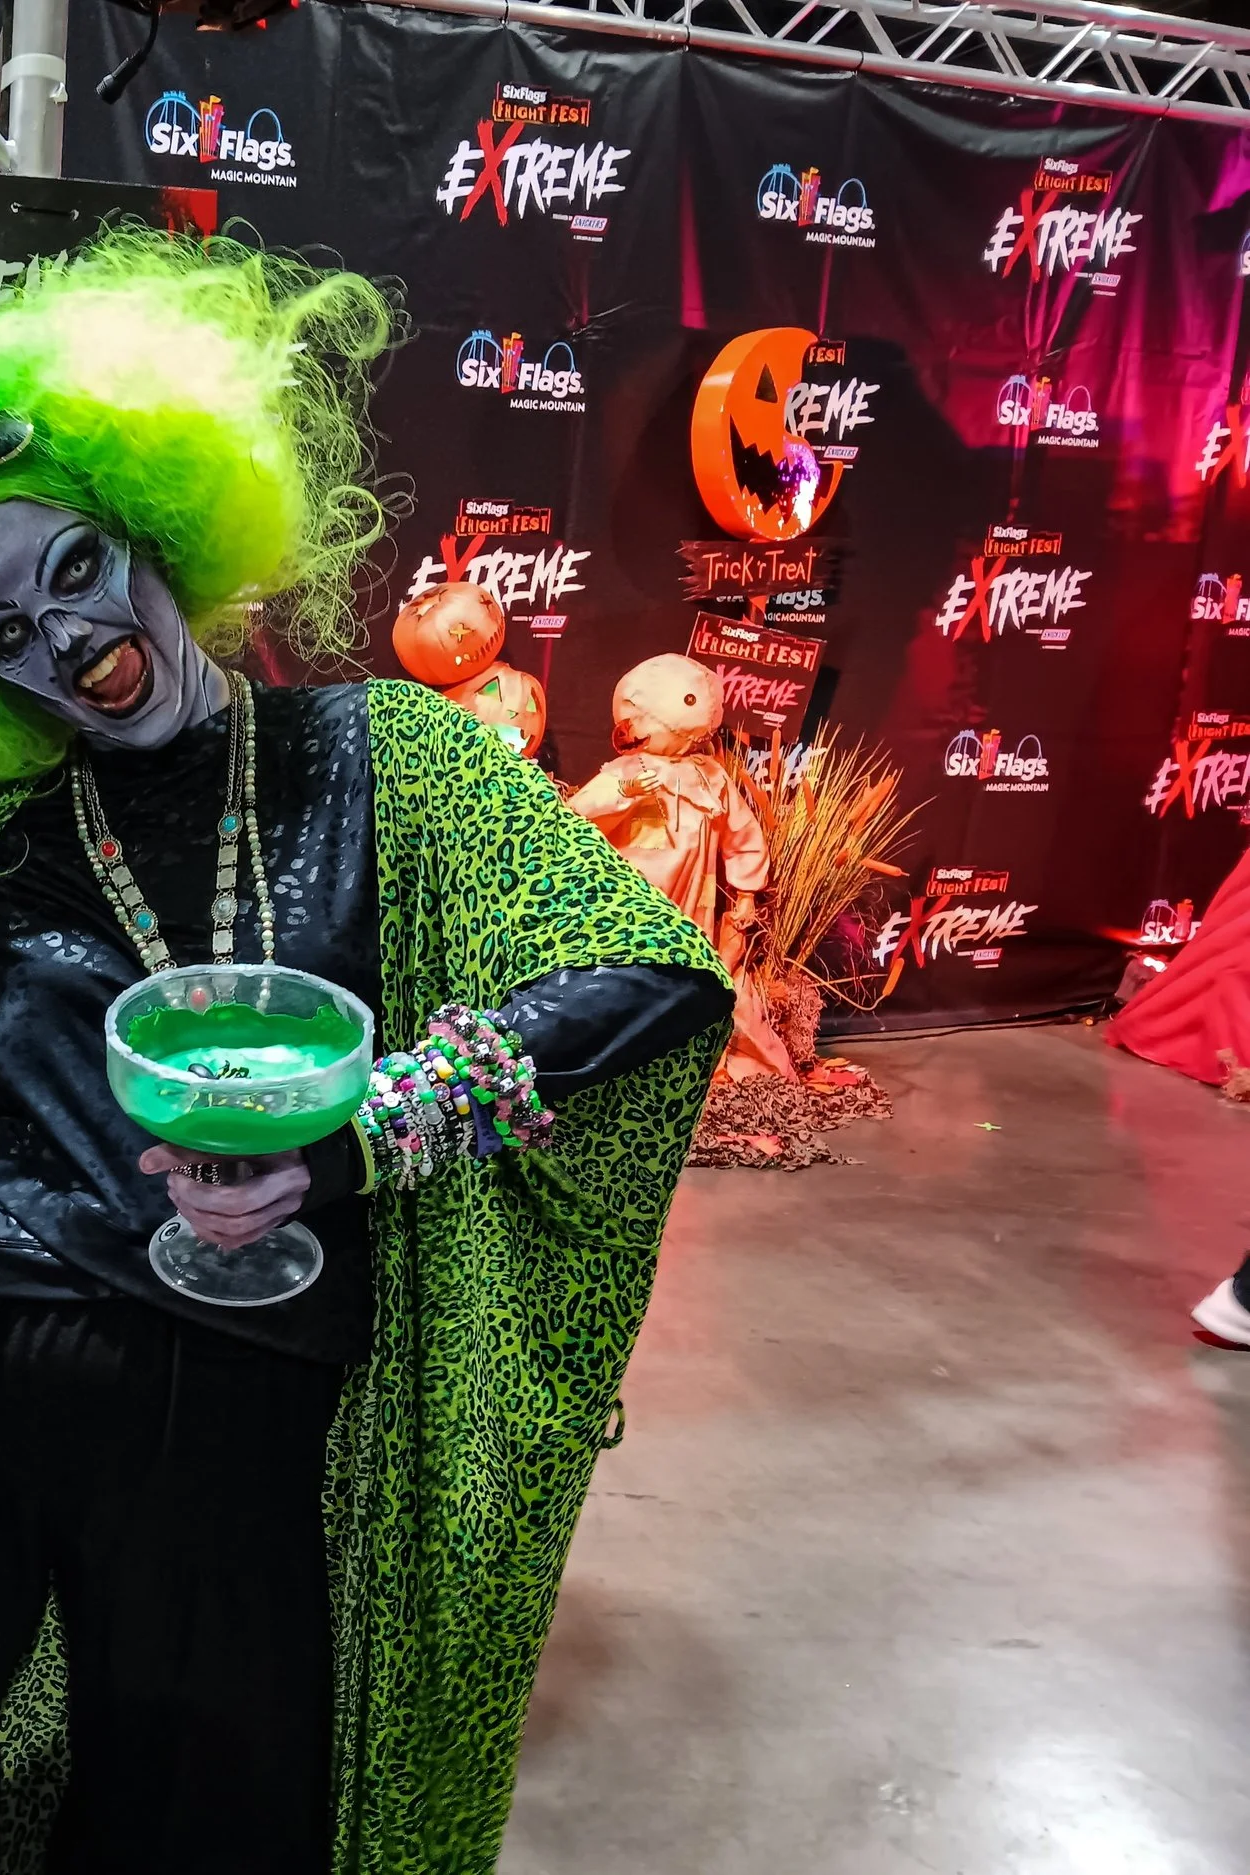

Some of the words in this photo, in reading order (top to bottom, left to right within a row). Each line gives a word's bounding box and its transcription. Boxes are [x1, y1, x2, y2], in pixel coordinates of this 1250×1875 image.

[502, 84, 548, 104] SixFlags
[497, 100, 546, 122] FRIGHT
[550, 103, 589, 125] FEST
[150, 122, 199, 158] Six
[210, 168, 243, 183] MAGIC
[244, 171, 297, 188] MOUNTAIN
[436, 117, 631, 227] EXTREME
[1079, 174, 1110, 193] FEST
[760, 190, 800, 221] Six
[806, 231, 832, 244] MAGIC
[832, 235, 876, 248] MOUNTAIN
[984, 190, 1143, 283] EXTREME
[808, 346, 844, 365] FEST
[459, 358, 502, 388] Six
[510, 398, 538, 410] MAGIC
[539, 401, 586, 413] MOUNTAIN
[998, 399, 1032, 426] Six
[1038, 435, 1061, 446] MAGIC
[1062, 438, 1099, 448] MOUNTAIN
[465, 502, 509, 517] SixFlags
[512, 513, 548, 533] FEST
[1030, 538, 1060, 554] FEST
[935, 556, 1093, 642] EXTREME
[1191, 595, 1225, 620] Six
[781, 613, 826, 623] MOUNTAIN
[701, 632, 764, 660] FRIGHT
[766, 642, 815, 670] FEST
[946, 752, 981, 776] Six
[985, 783, 1010, 792] MAGIC
[1010, 783, 1049, 792] MOUNTAIN
[872, 895, 1039, 969] EXTREME
[1141, 921, 1175, 944] Six
